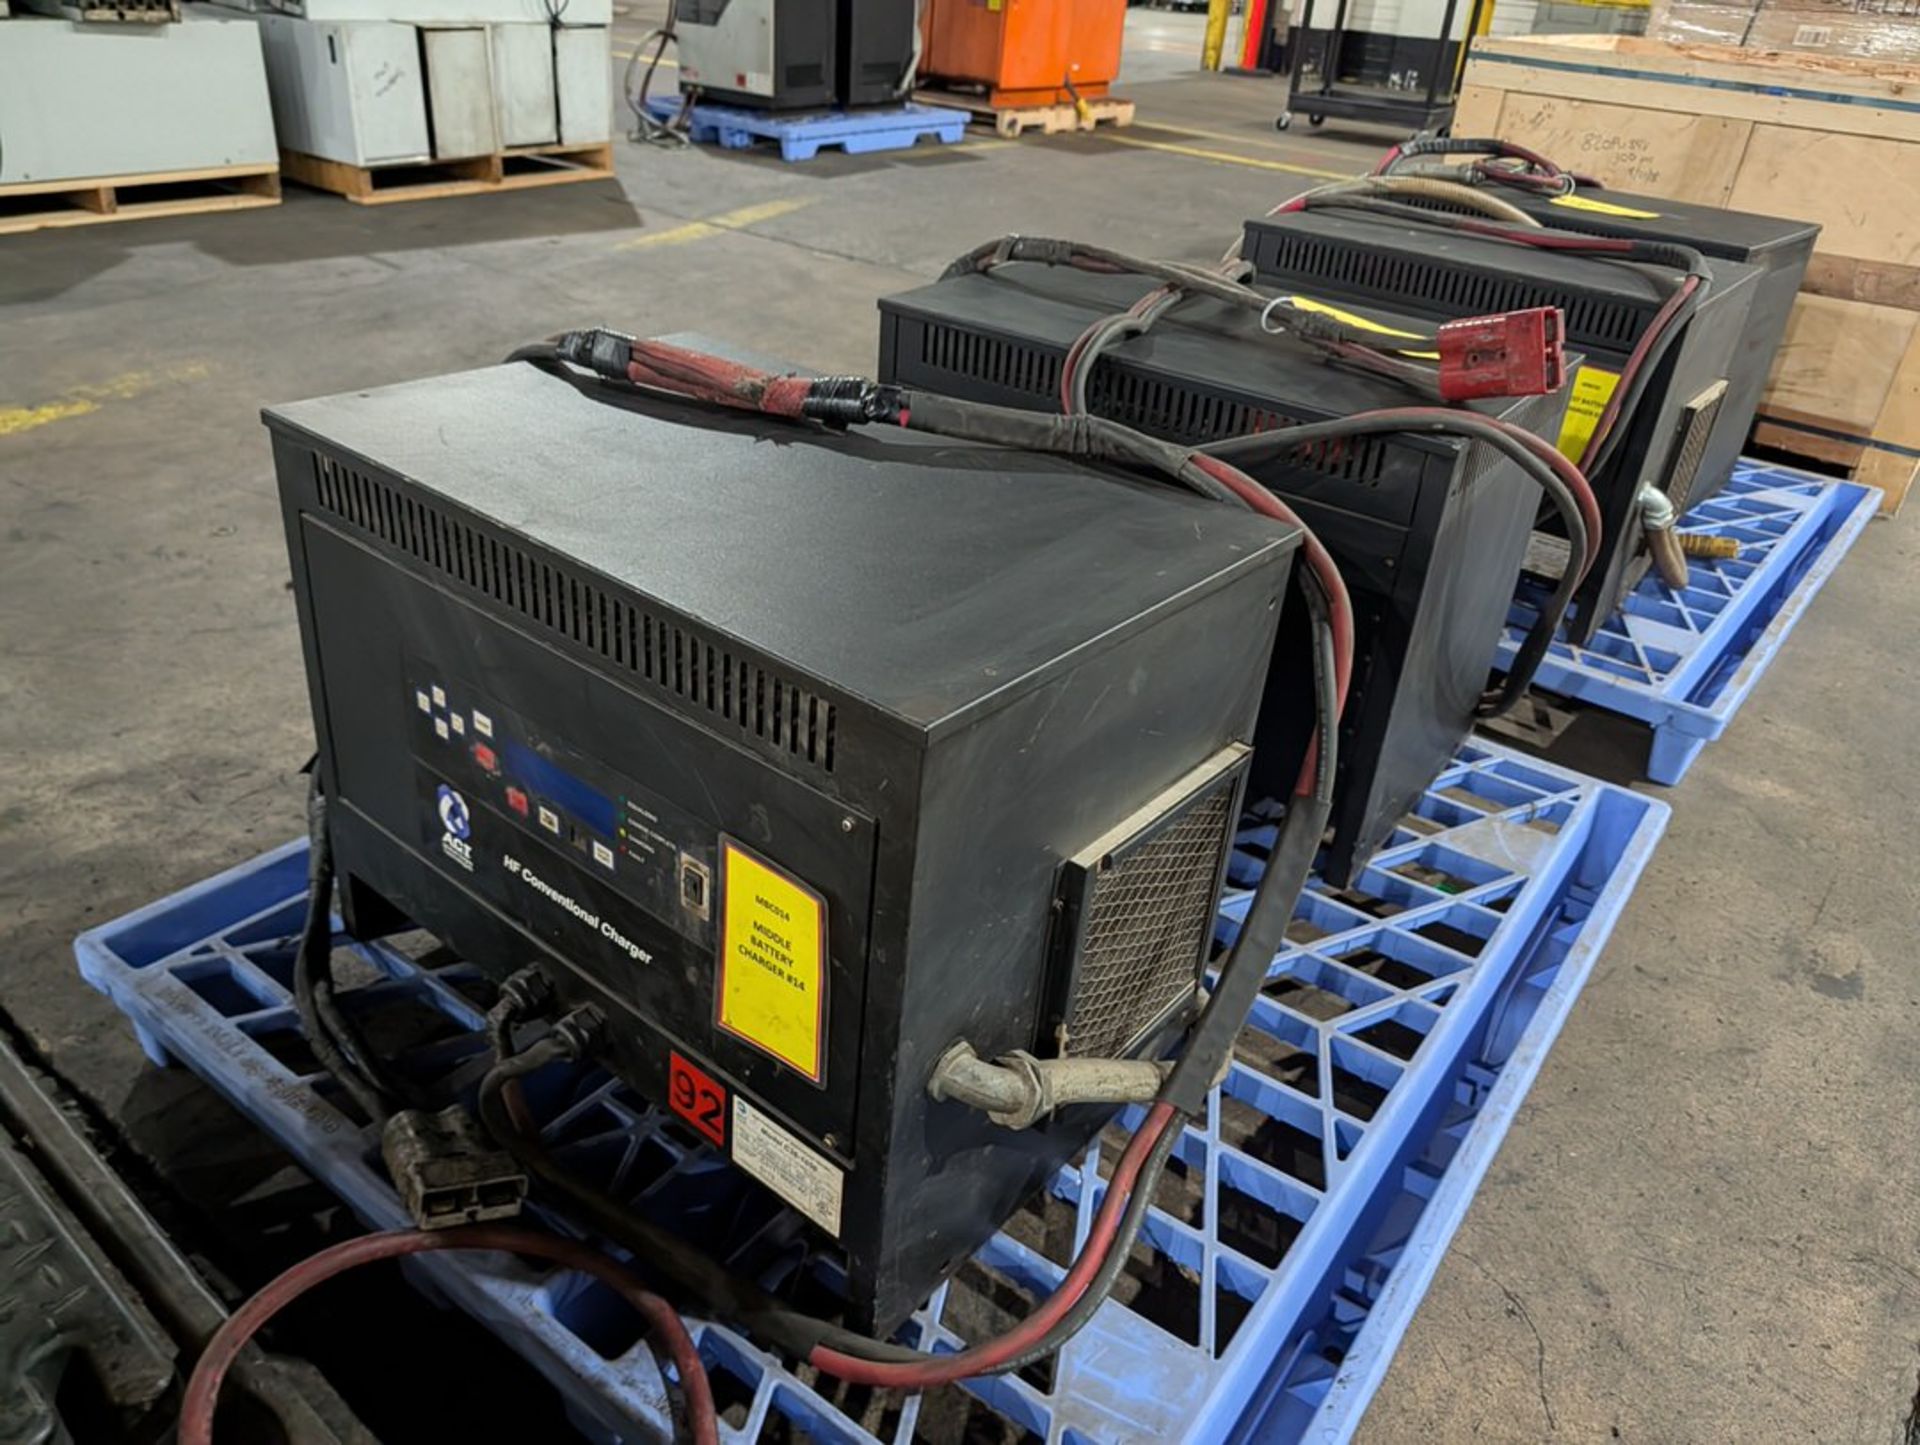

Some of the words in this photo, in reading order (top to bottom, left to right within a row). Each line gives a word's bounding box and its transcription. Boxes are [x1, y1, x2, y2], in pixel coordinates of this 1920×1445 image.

[442, 832, 473, 859] ACT
[502, 854, 522, 873] HF
[521, 867, 600, 930] Conventional
[600, 922, 654, 965] Charger
[749, 934, 794, 968] BATTERY
[752, 920, 793, 952] MIDDLE
[737, 943, 785, 981] CHARGER
[785, 973, 806, 992] #14
[674, 1069, 724, 1135] 92
